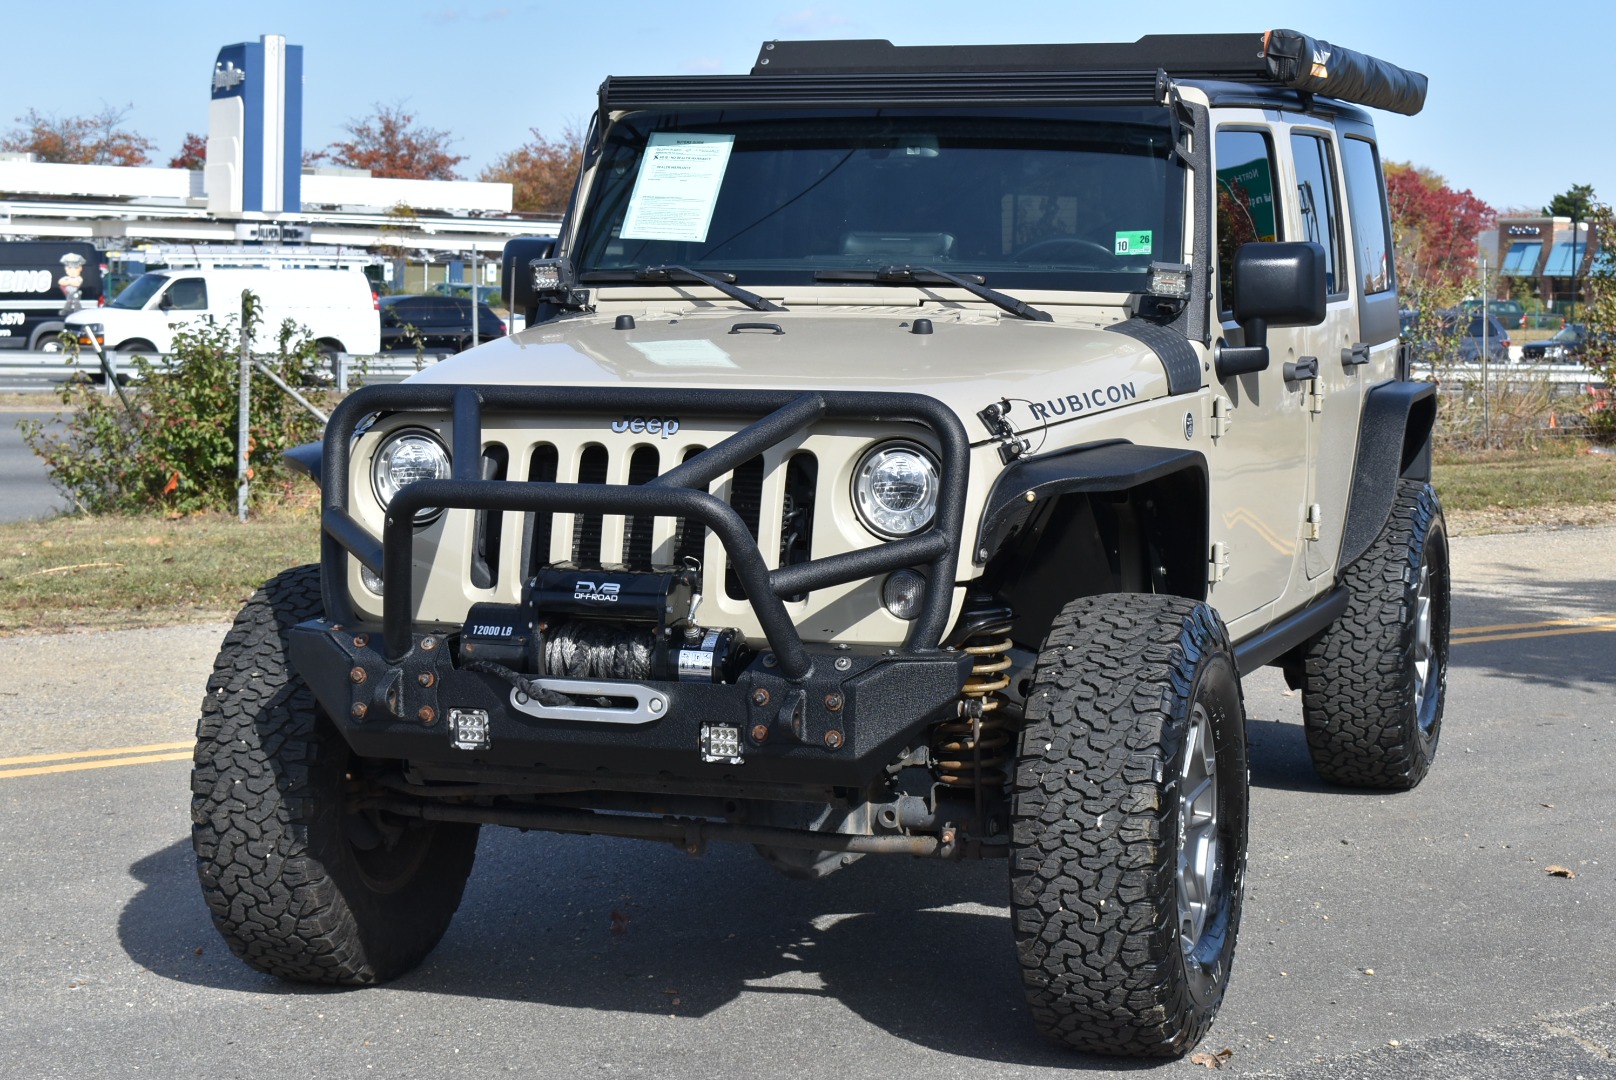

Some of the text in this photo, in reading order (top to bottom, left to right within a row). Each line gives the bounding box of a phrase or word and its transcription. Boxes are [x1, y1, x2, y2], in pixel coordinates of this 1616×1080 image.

[1140, 235, 1150, 244] 26
[1117, 240, 1128, 252] 10
[1028, 381, 1137, 421] RUBICON
[611, 416, 679, 439] Jeep
[473, 625, 513, 636] 12000 LB
